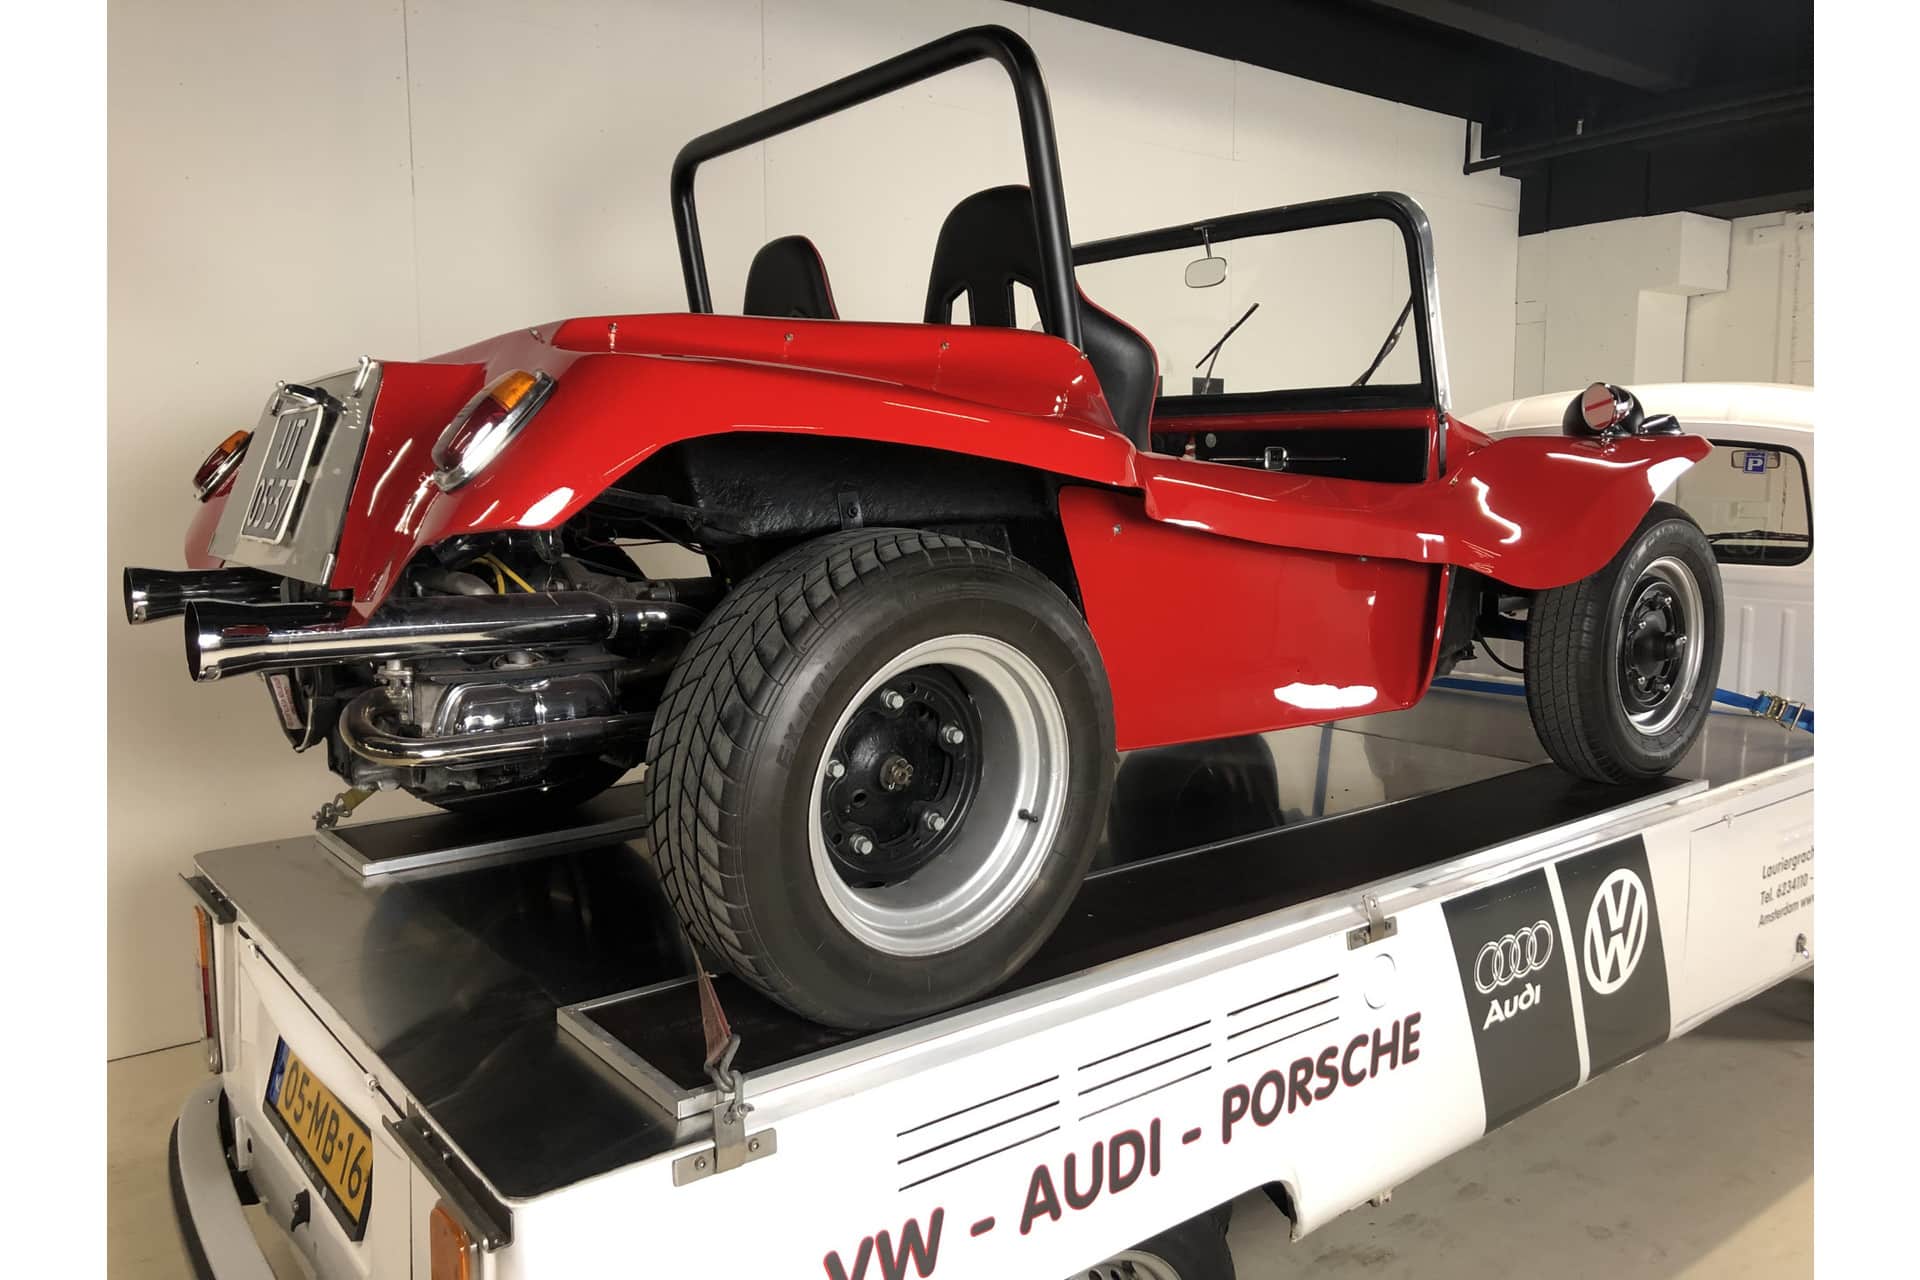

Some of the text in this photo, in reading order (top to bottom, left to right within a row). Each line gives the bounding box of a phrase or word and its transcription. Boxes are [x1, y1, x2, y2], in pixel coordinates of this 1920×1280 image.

[276, 418, 308, 469] UT
[1747, 458, 1763, 471] P
[1757, 901, 1799, 928] Amsterdam
[1483, 983, 1541, 1031] Audi
[284, 1060, 366, 1200] 05-MB-16
[823, 1206, 945, 1280] VW
[1019, 1117, 1161, 1235] AUDI
[1222, 1011, 1422, 1144] PORSCHE
